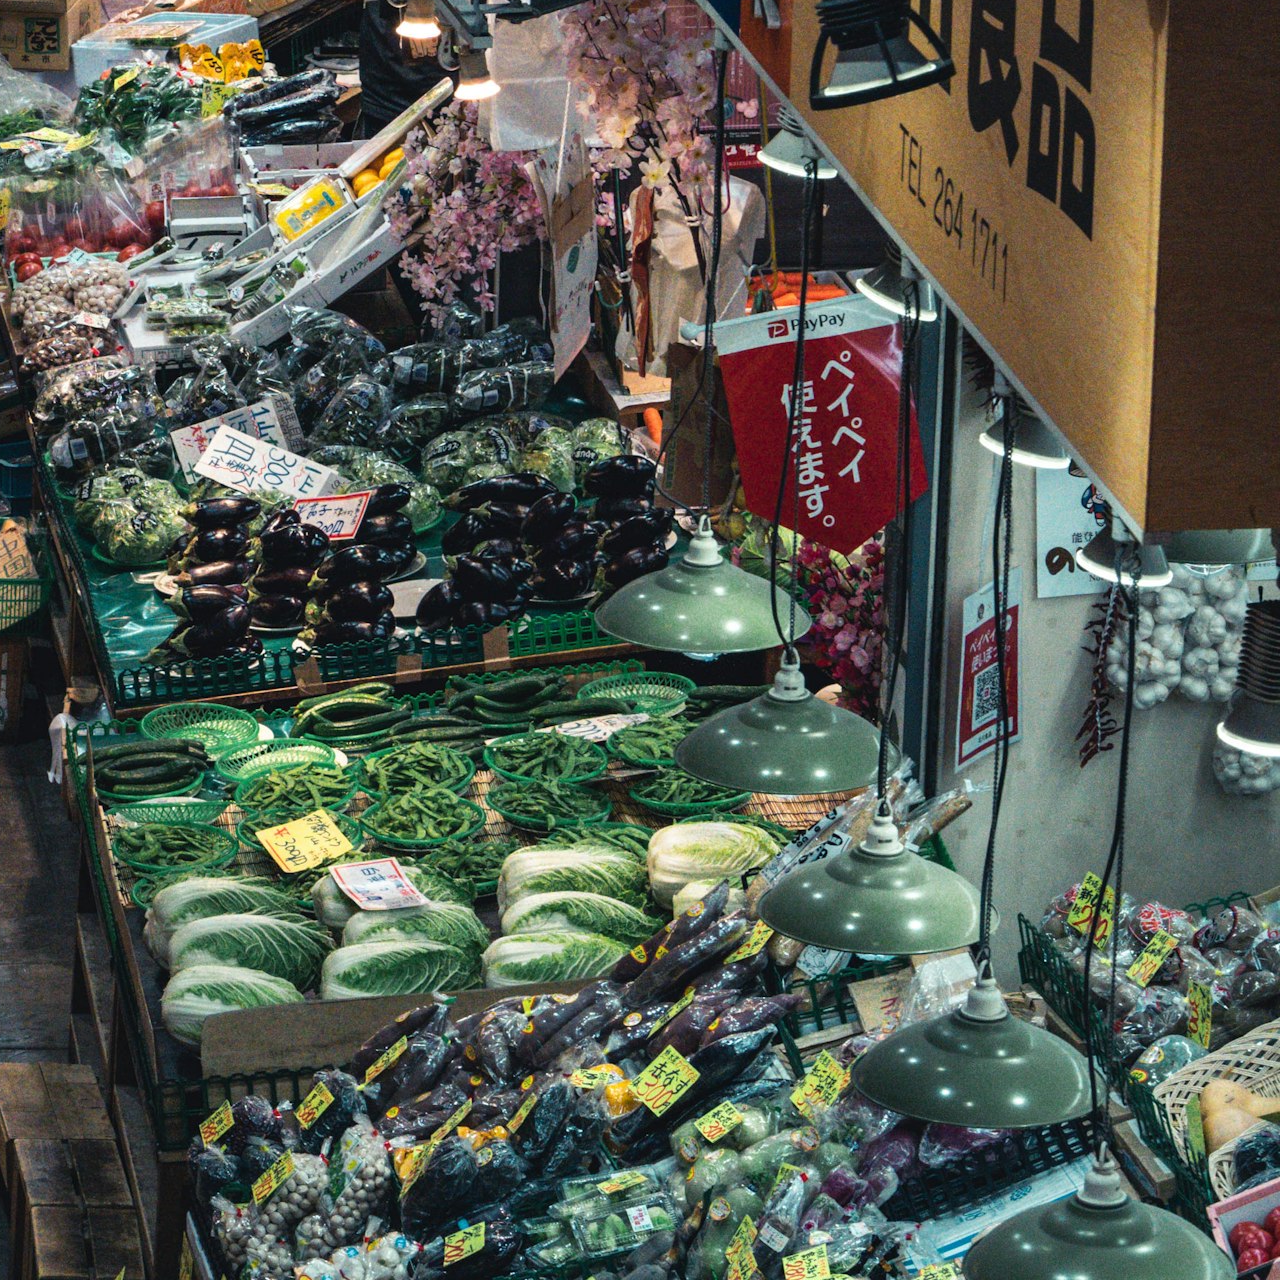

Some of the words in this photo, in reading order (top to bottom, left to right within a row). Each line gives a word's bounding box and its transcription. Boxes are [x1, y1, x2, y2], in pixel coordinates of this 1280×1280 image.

[899, 121, 927, 209] TEL
[933, 164, 965, 251] 264
[971, 211, 1010, 304] 1711
[790, 312, 847, 333] PayPay
[820, 350, 867, 484] ペイペイ
